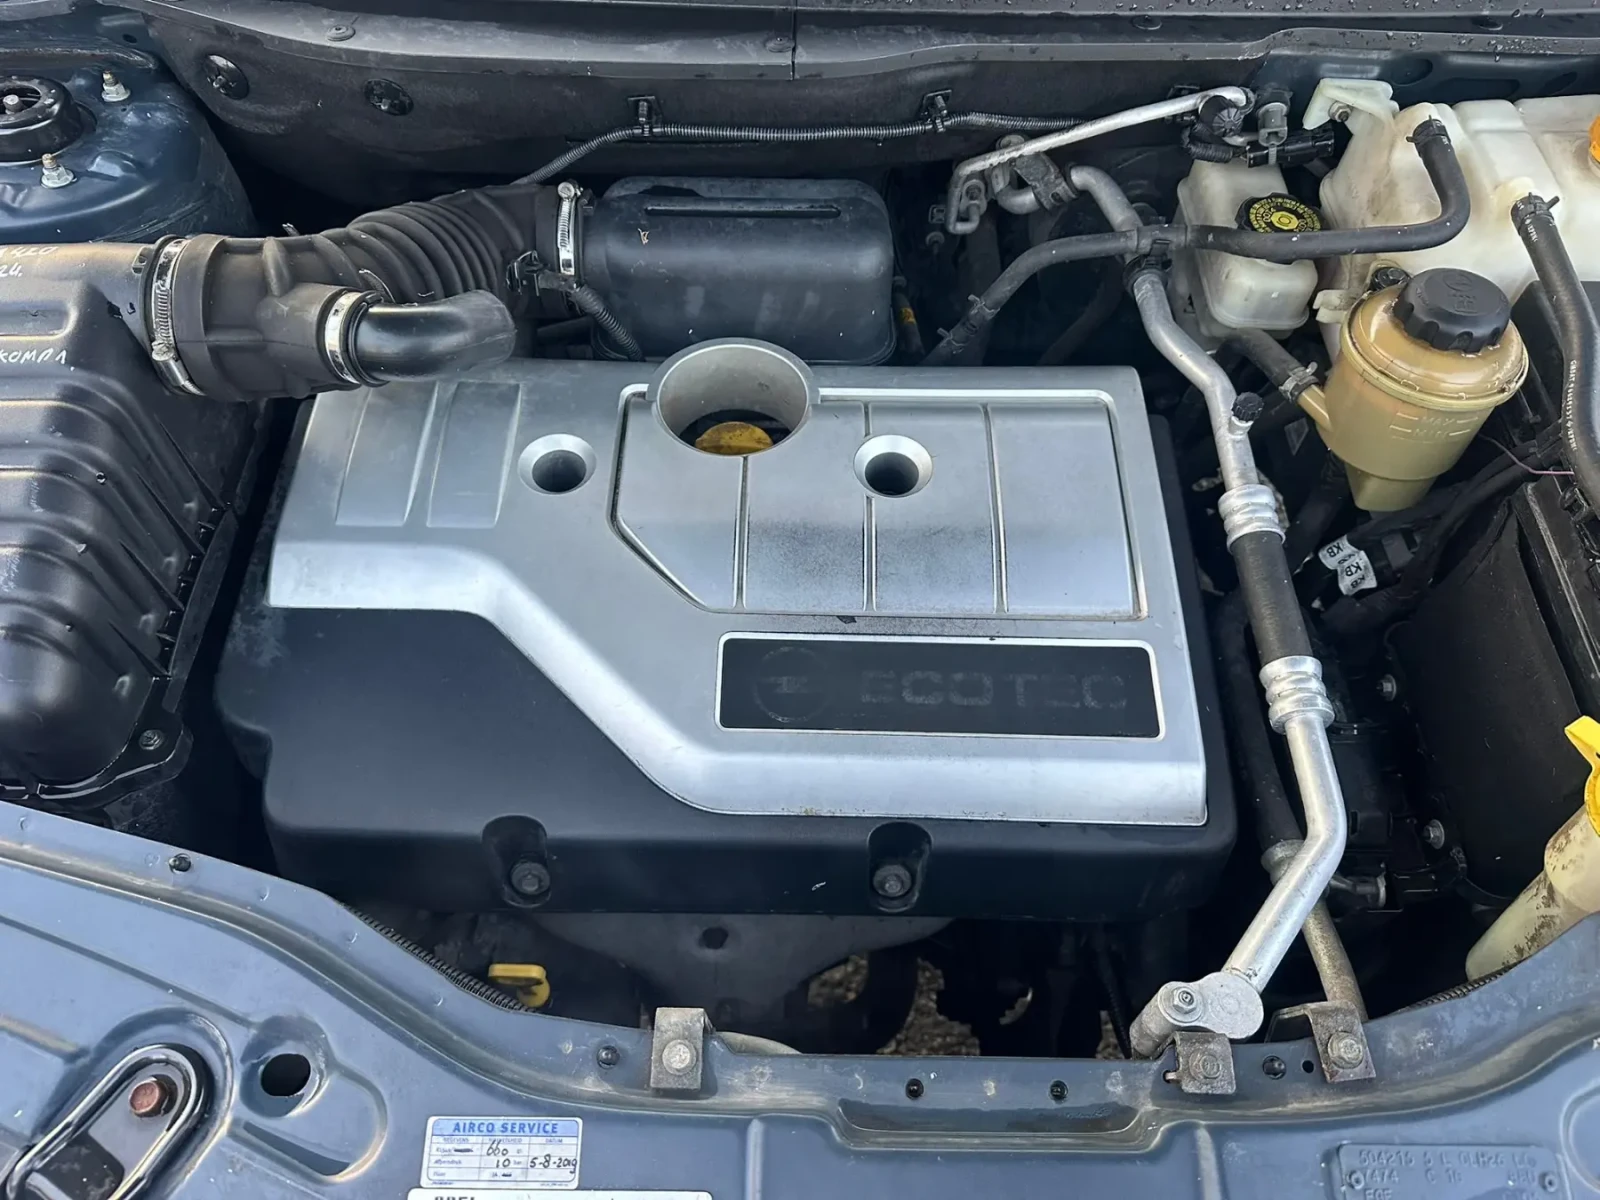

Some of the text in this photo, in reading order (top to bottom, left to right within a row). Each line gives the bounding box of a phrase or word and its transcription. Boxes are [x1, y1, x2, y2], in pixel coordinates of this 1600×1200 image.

[1421, 416, 1455, 426] MAX
[1326, 541, 1343, 558] KB
[1345, 562, 1362, 577] KB
[859, 669, 1128, 710] ECOTEC
[452, 1121, 558, 1134] AIRCO SERVICE
[495, 1158, 511, 1169] 10
